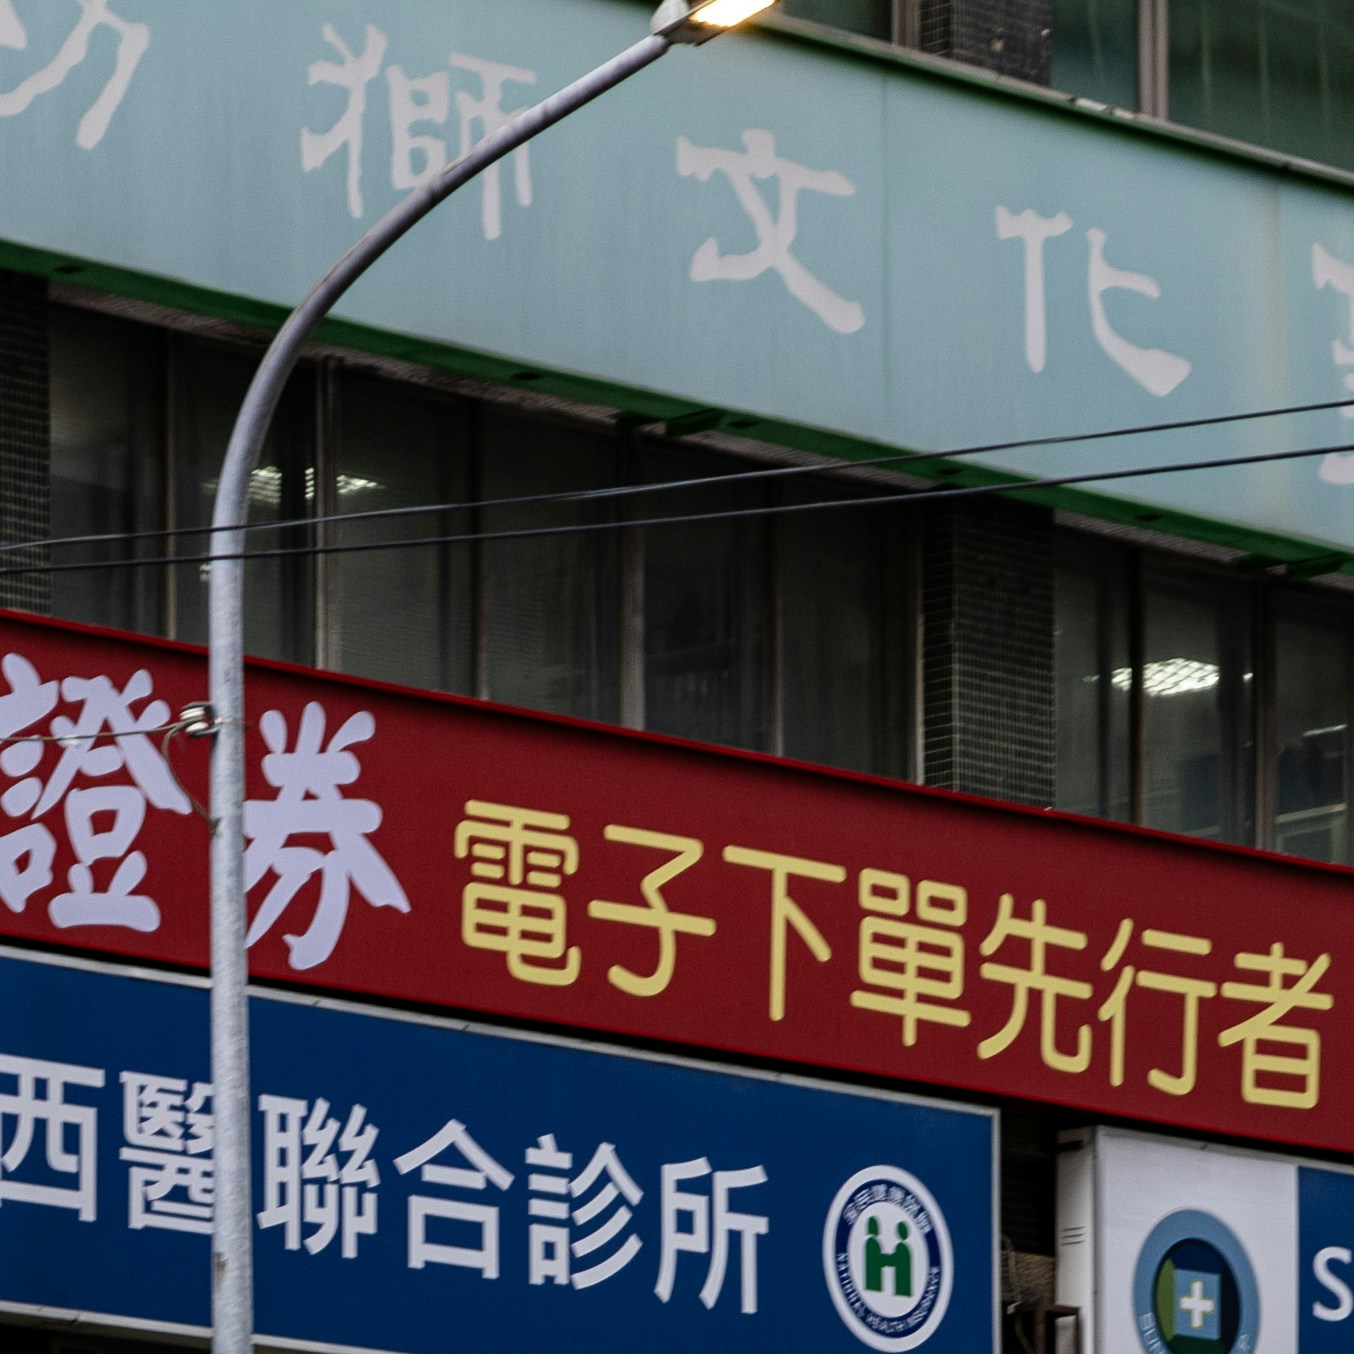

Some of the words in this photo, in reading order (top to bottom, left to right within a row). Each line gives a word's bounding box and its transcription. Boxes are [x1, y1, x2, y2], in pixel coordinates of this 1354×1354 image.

[455, 799, 1334, 1109] 電子下單先行者
[0, 1054, 769, 1315] 西醫聯合診所
